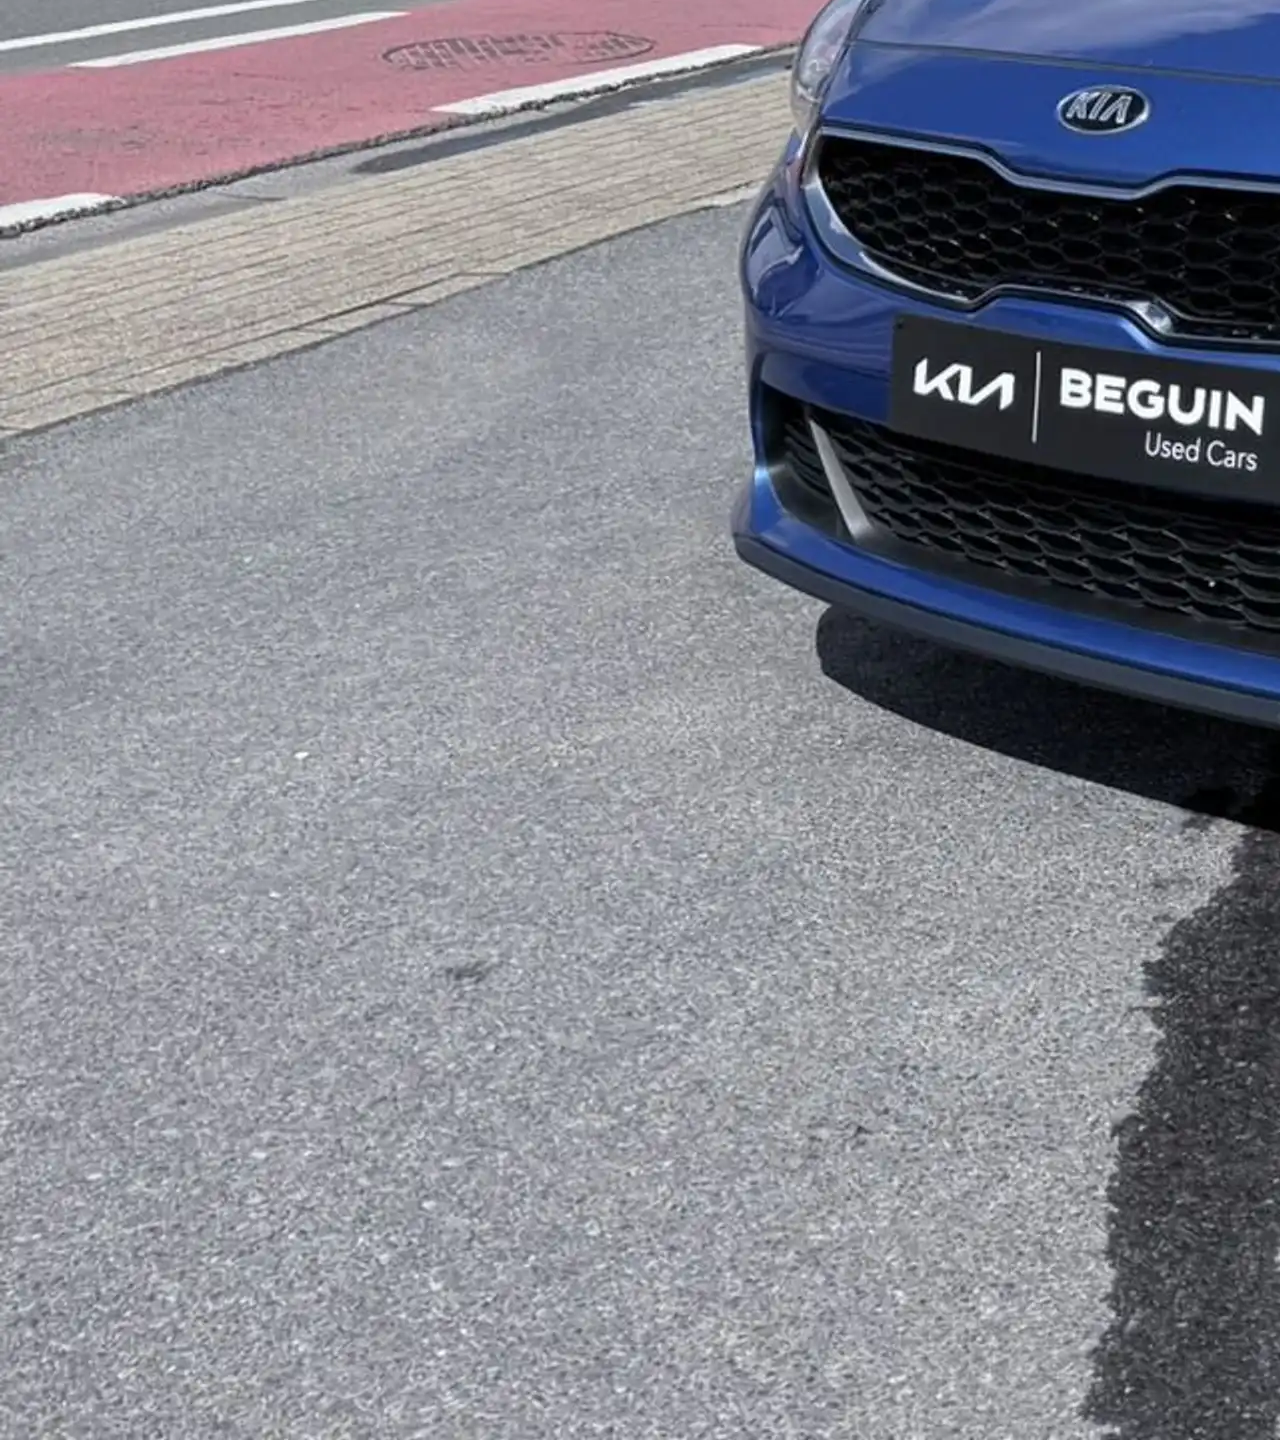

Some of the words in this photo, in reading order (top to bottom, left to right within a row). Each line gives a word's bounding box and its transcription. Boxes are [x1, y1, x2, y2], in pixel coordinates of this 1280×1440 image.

[1066, 91, 1133, 125] KIA
[913, 357, 1015, 411] KIA
[1060, 366, 1265, 436] BEGUIN
[1145, 430, 1201, 463] Used
[1206, 439, 1258, 473] Cars
